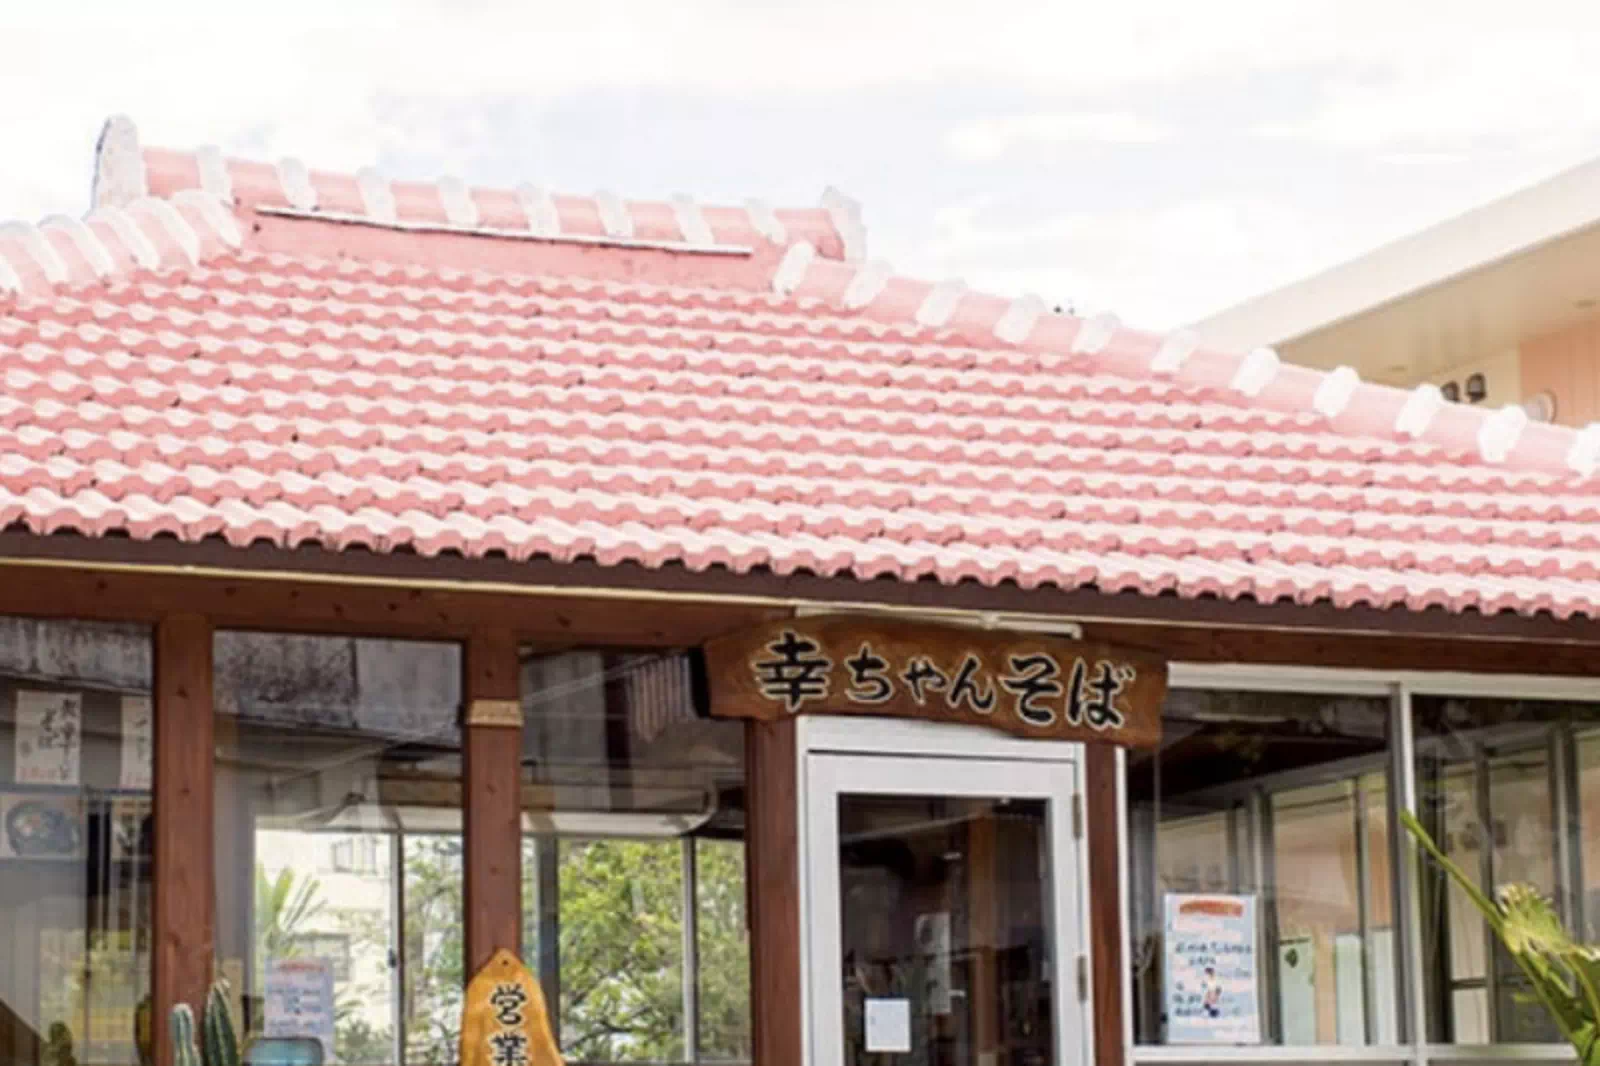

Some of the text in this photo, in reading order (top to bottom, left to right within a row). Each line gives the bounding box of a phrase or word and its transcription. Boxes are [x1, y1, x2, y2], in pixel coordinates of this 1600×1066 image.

[751, 630, 1134, 729] 幸ちゃんそば
[489, 982, 528, 1066] 営業
